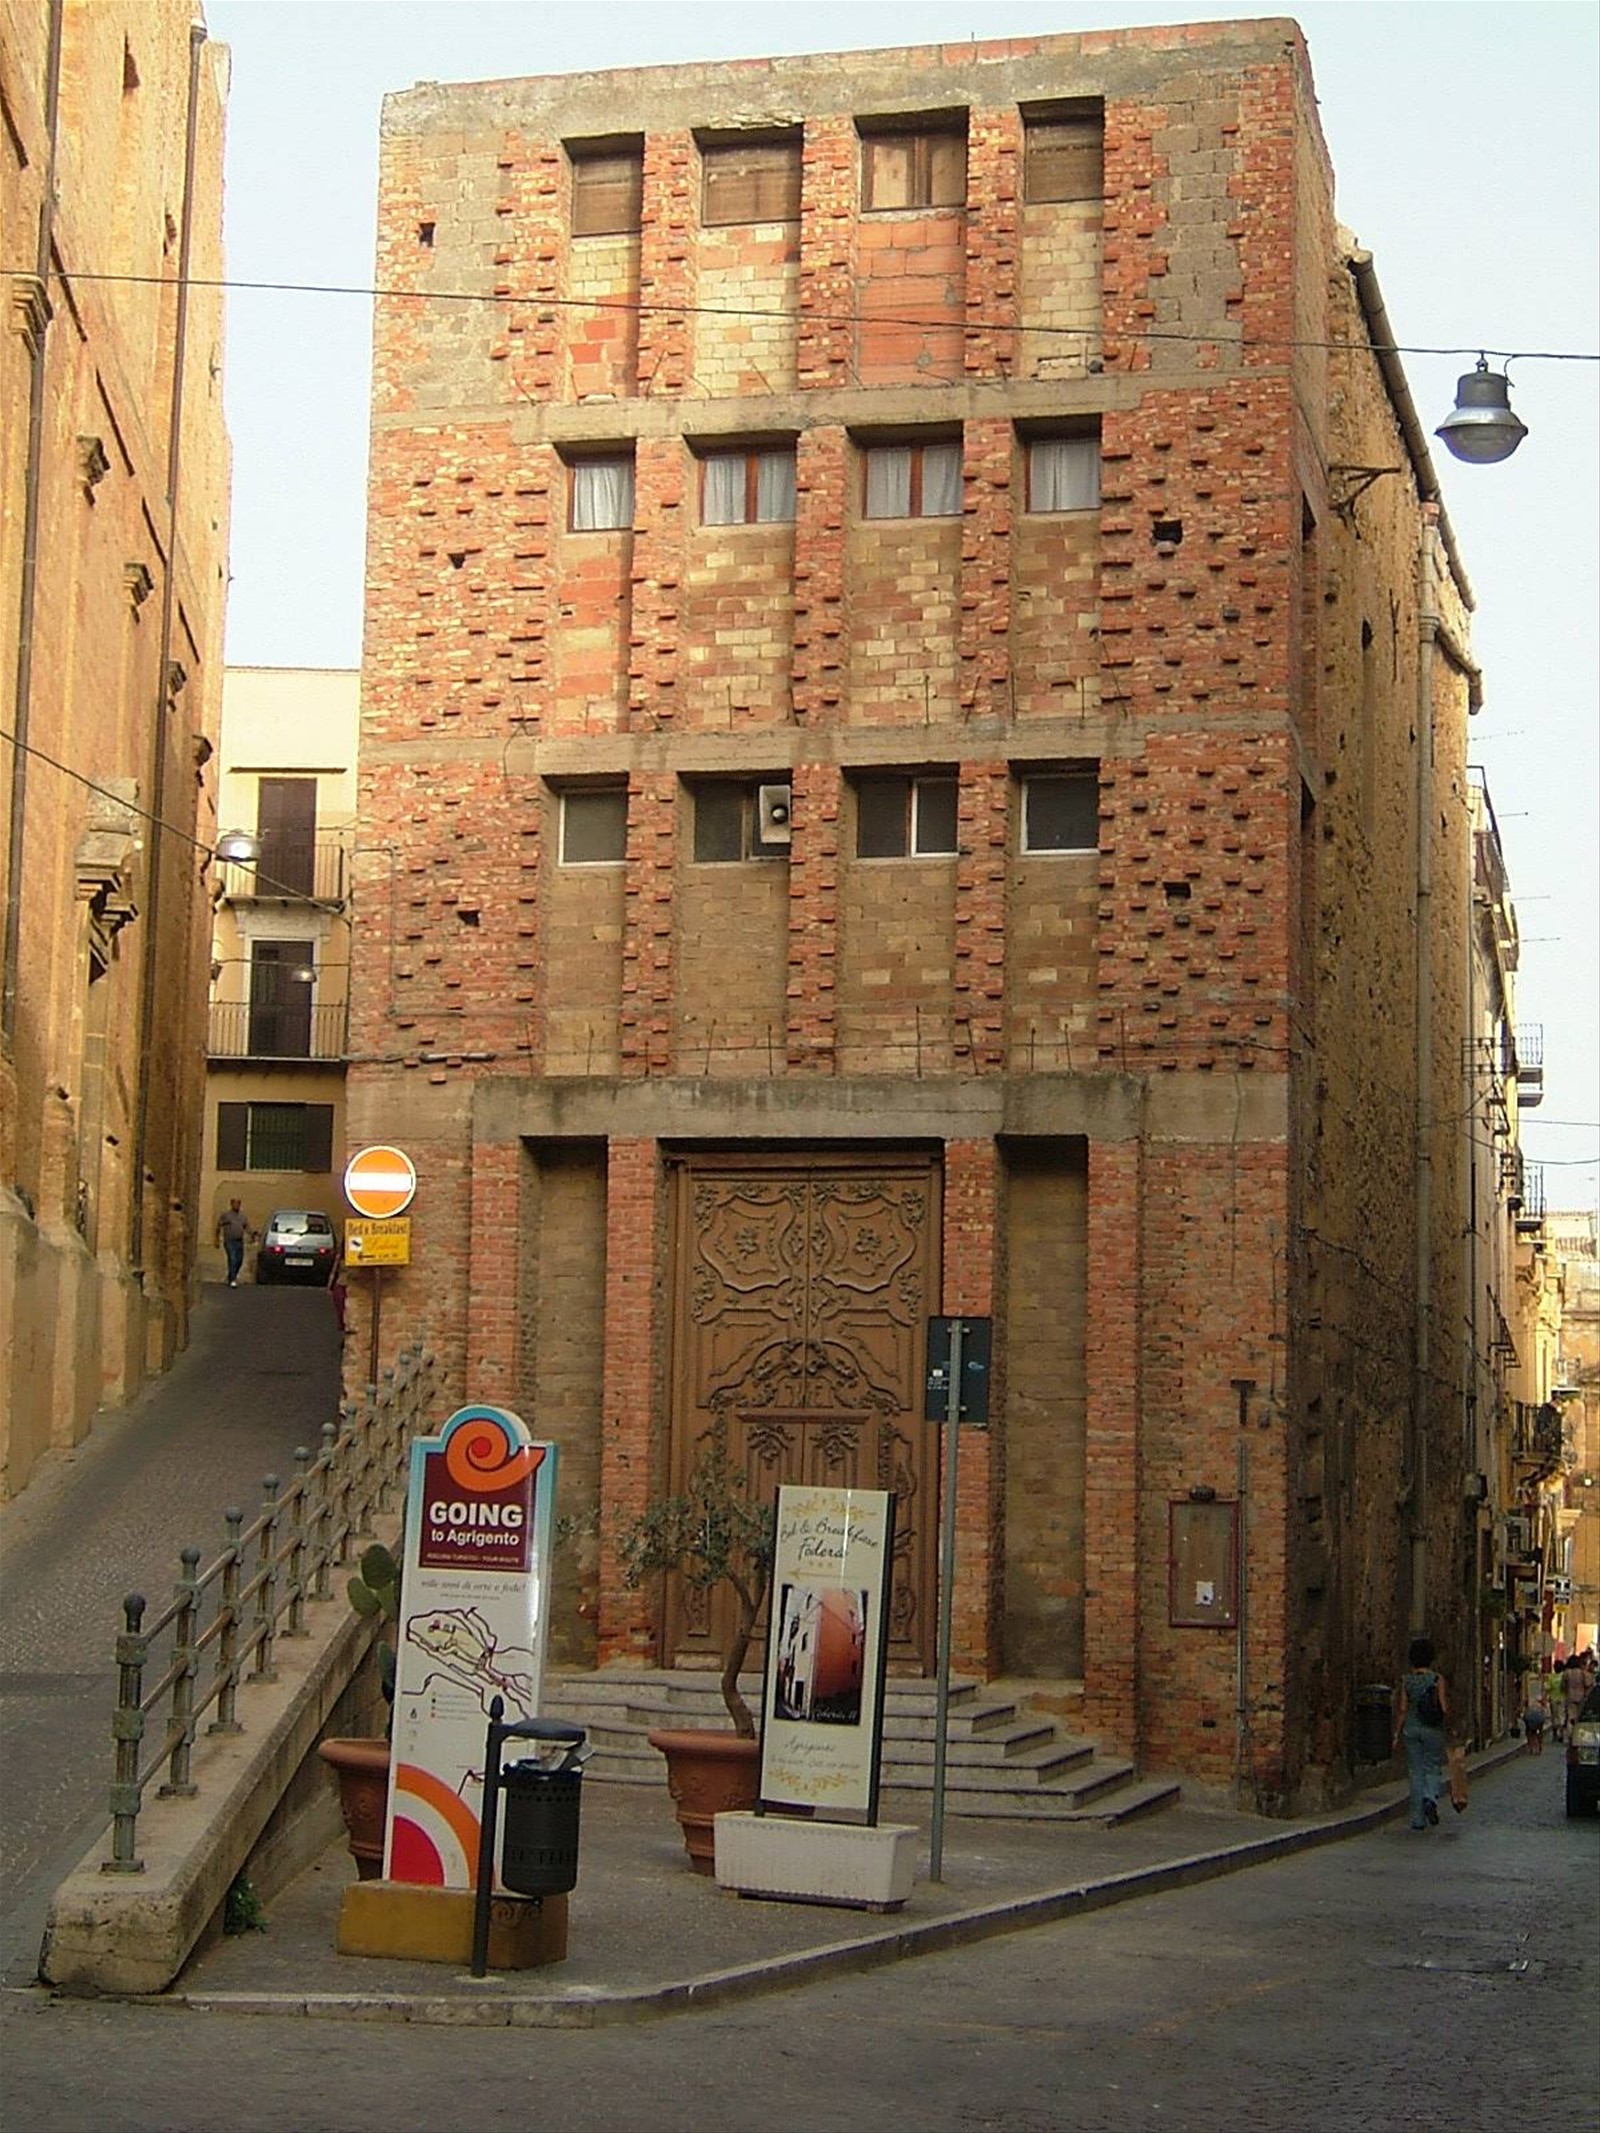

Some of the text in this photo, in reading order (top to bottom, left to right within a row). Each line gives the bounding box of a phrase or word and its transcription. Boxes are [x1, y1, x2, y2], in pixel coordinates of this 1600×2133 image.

[429, 1501, 523, 1528] GOING
[432, 1529, 519, 1547] to Agrigento
